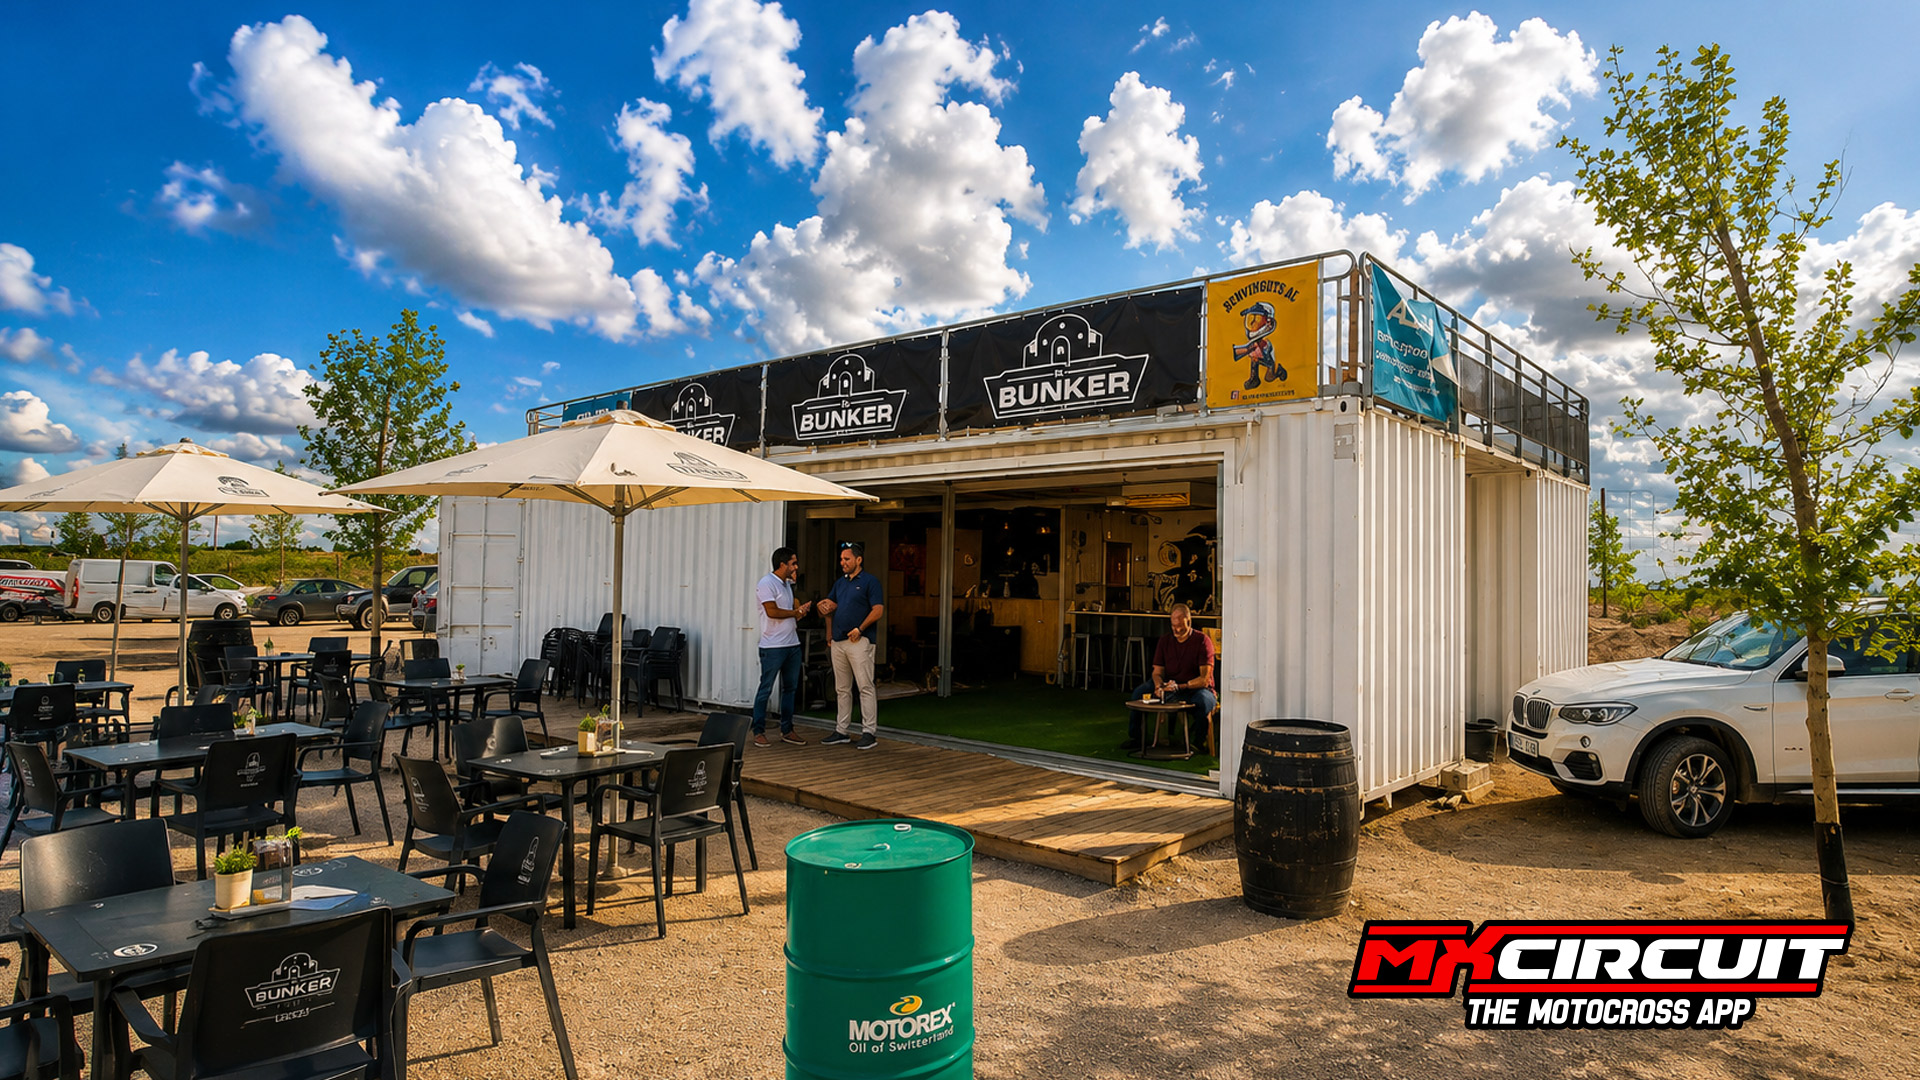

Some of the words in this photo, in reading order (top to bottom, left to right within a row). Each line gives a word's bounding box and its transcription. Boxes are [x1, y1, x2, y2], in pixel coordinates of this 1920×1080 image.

[999, 371, 1131, 409] BUNKER
[799, 404, 894, 432] BUNKER
[255, 976, 332, 1003] BUNKER
[849, 1004, 953, 1041] MOTOREX
[871, 1041, 885, 1054] of
